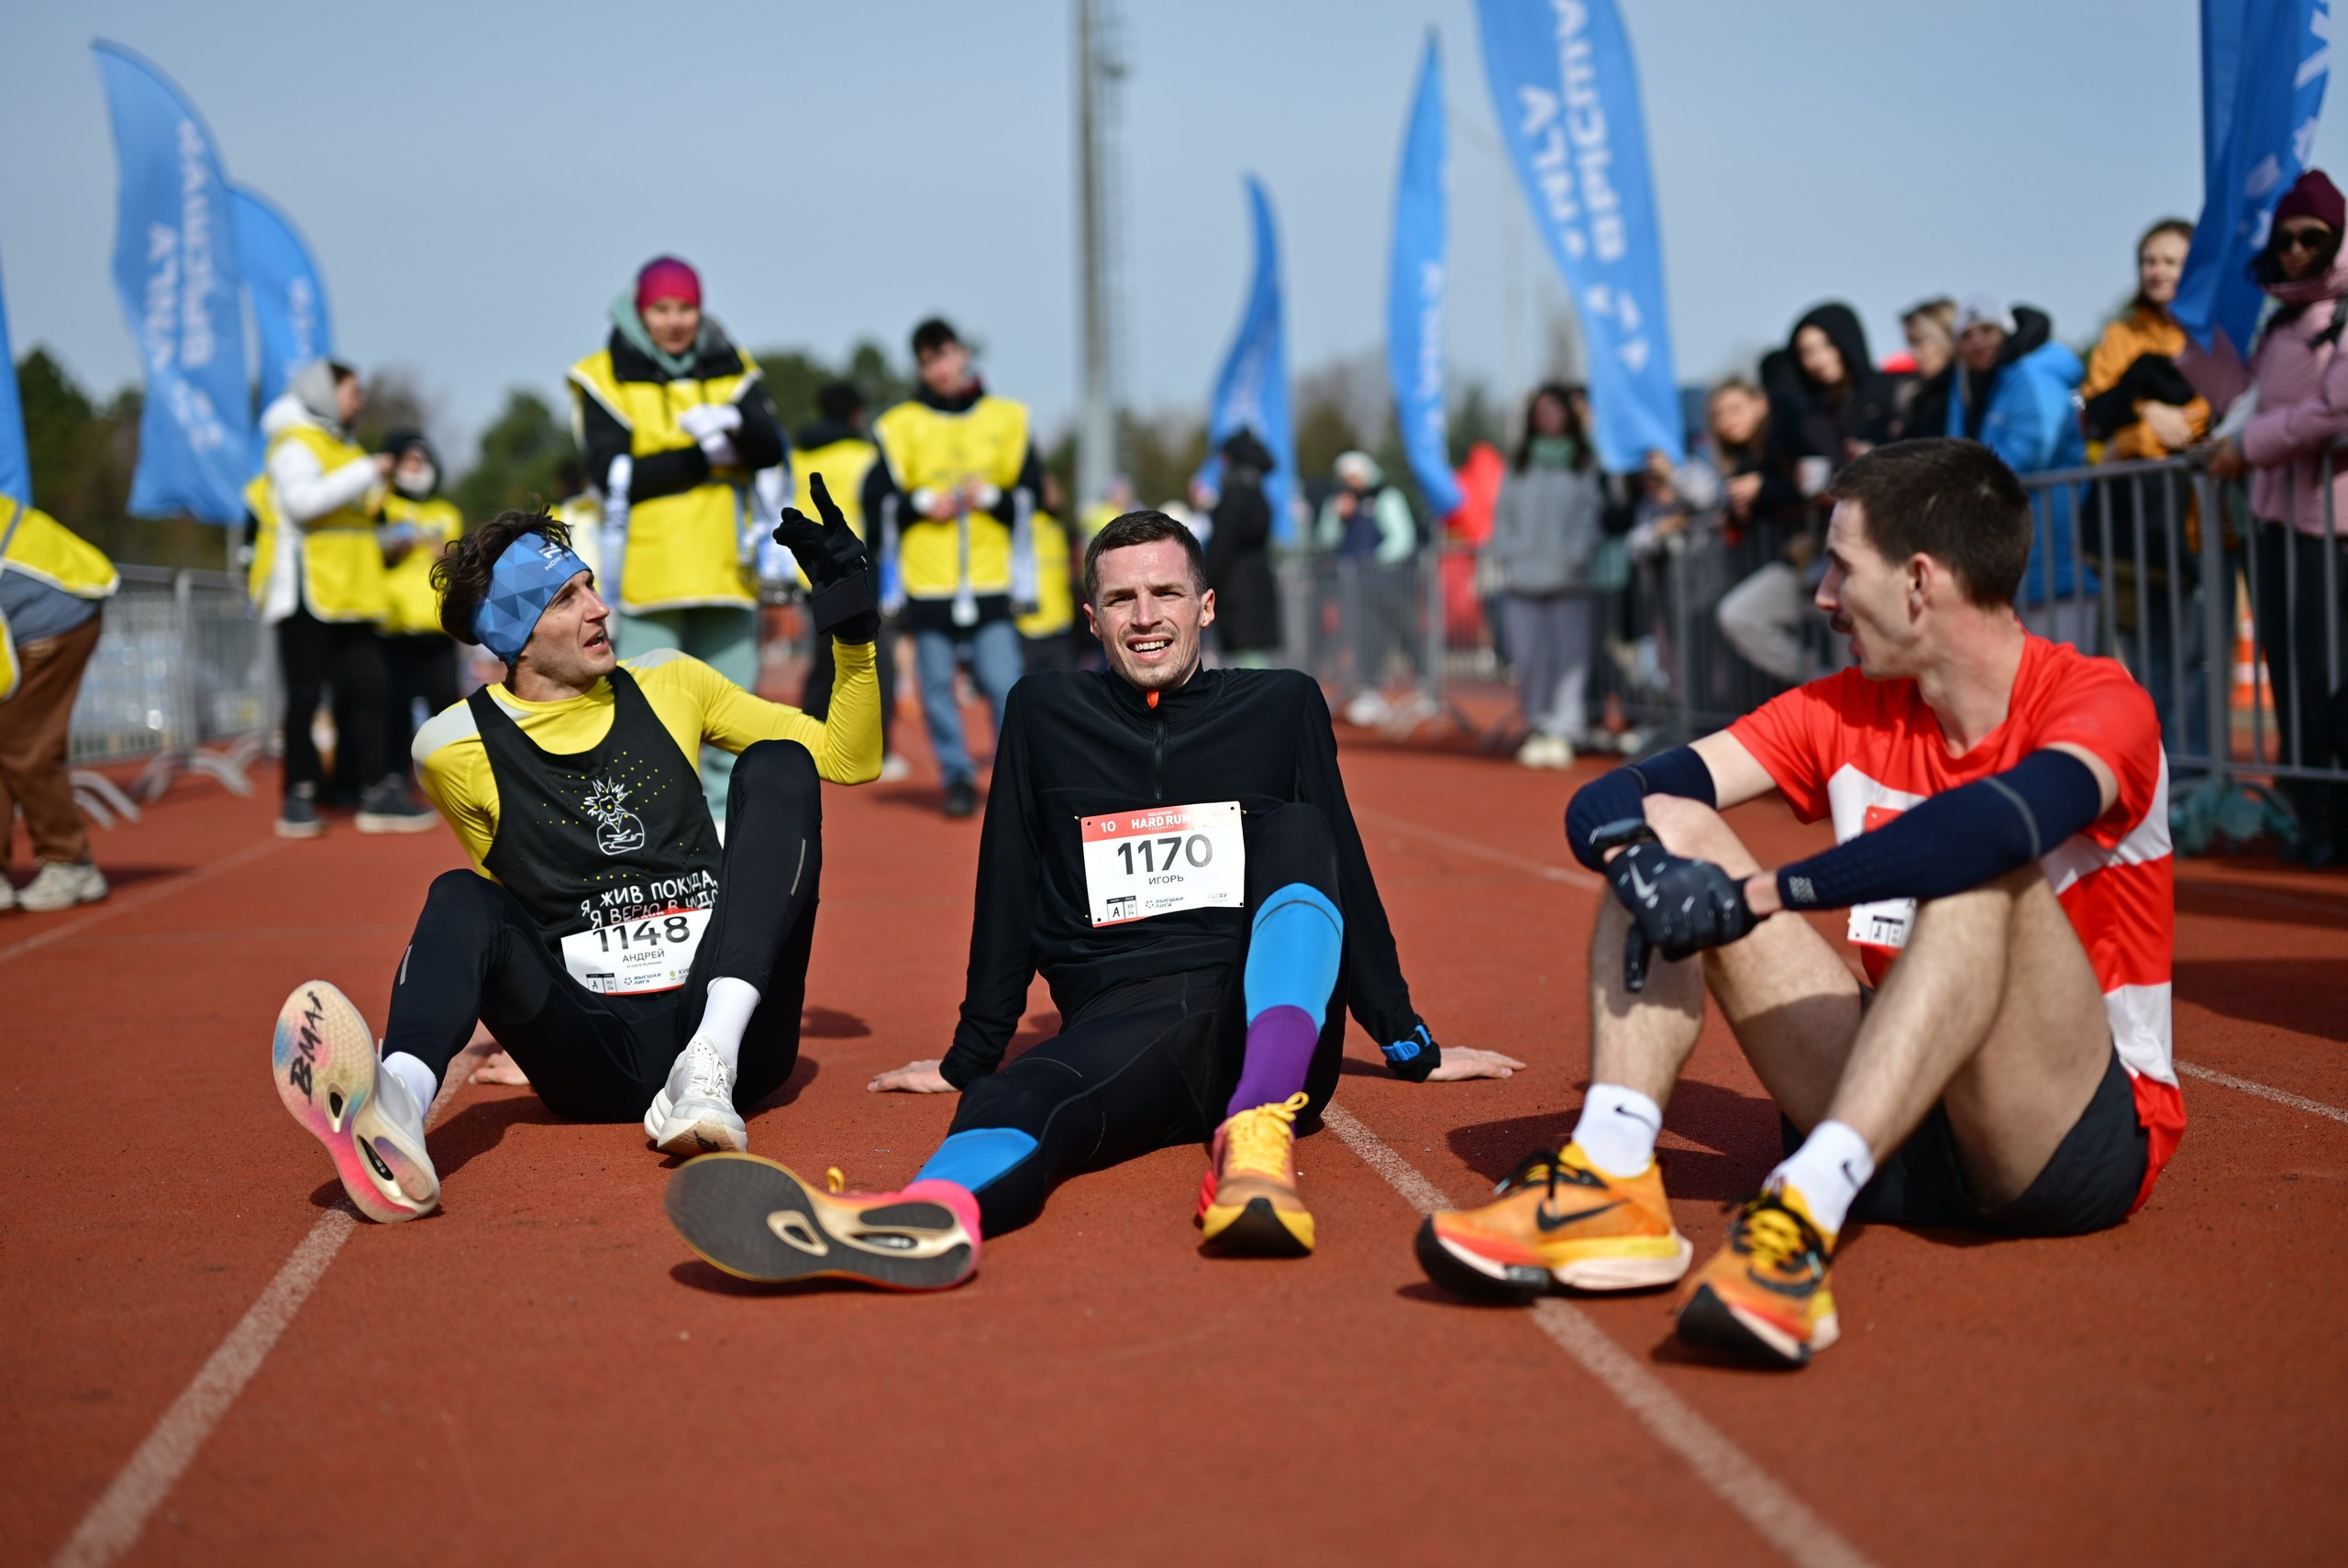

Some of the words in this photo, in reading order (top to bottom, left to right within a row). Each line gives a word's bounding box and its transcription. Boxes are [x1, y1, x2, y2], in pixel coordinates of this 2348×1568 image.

[1100, 820, 1117, 834] 10
[1131, 816, 1165, 830] HARD
[1165, 812, 1191, 826] RUN
[1117, 834, 1213, 876] 1170
[1148, 875, 1185, 886] ИГОРЬ
[581, 899, 590, 917] Я
[599, 885, 644, 908] ЖИВ
[650, 870, 719, 901] ПОКУДА,
[1155, 896, 1184, 904] ВЫСШАЯ
[589, 910, 603, 930] Я
[609, 902, 660, 924] ВЕРЮ
[593, 916, 691, 953] 1148
[622, 948, 666, 963] АНДРЕЙ
[633, 972, 662, 980] ВЫСШАЯ
